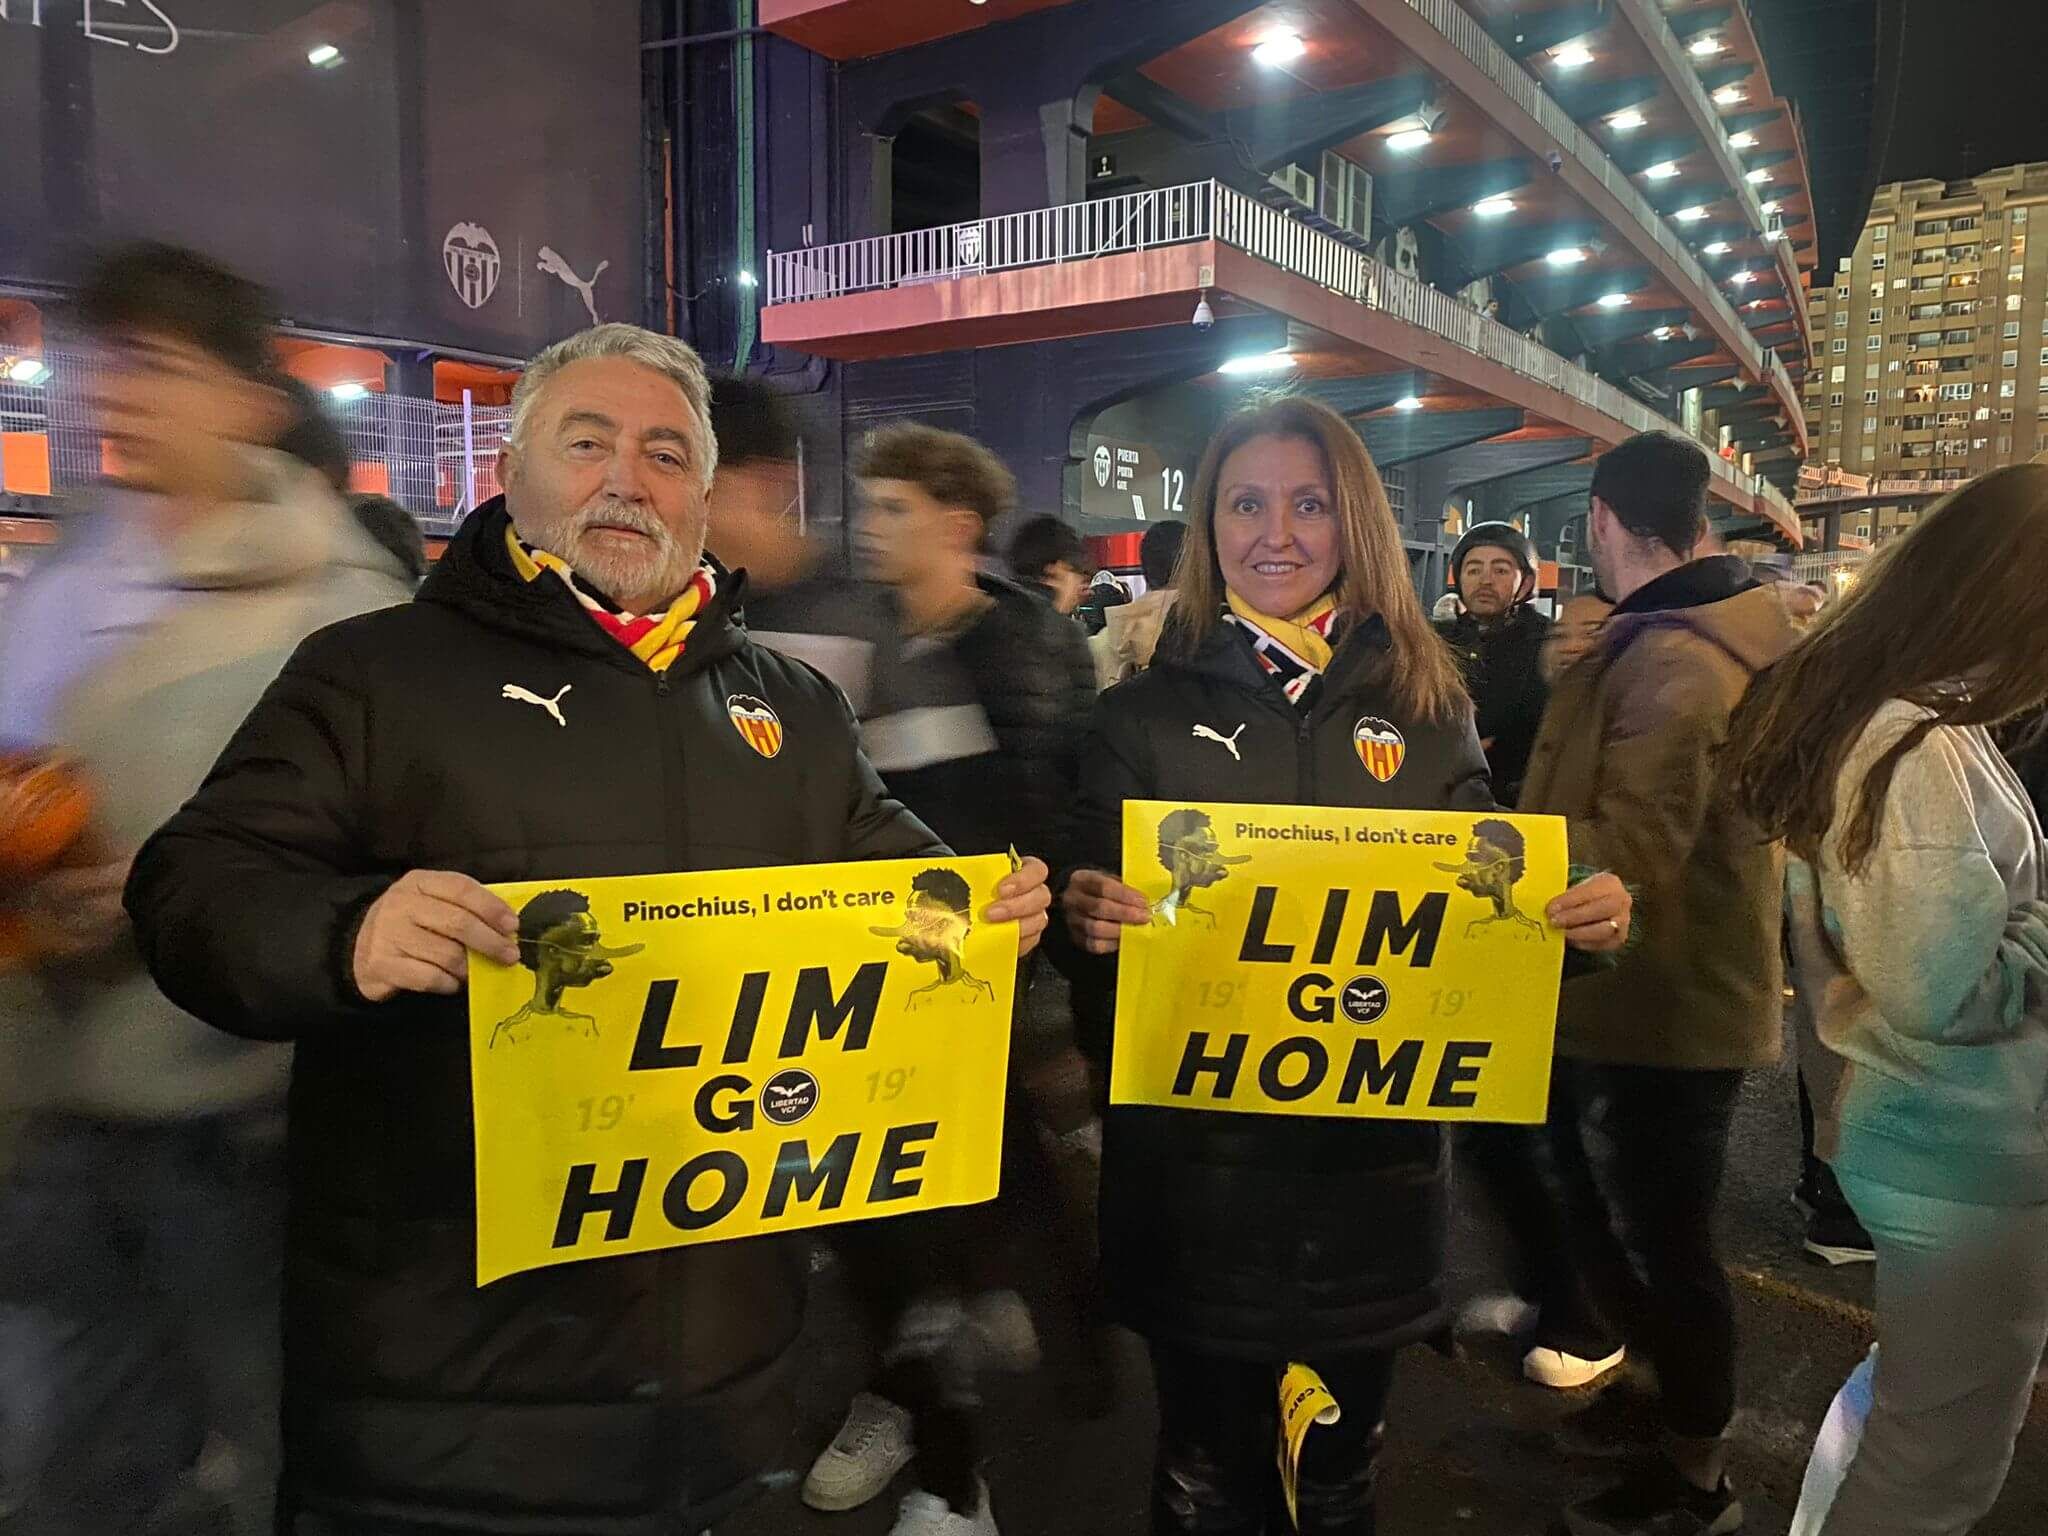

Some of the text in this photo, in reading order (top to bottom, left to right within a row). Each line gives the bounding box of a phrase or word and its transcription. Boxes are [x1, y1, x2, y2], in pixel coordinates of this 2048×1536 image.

[1162, 467, 1184, 511] 12
[1466, 499, 1473, 528] 8
[1235, 822, 1457, 847] Pinochius, I don't care
[622, 896, 757, 922] Pinochius,
[763, 894, 770, 913] I
[843, 887, 895, 907] care
[1238, 886, 1450, 968] LIM
[627, 961, 888, 1071] LIM
[1171, 1031, 1492, 1108] HOME
[770, 1096, 809, 1109] LIBERTAD
[780, 1105, 797, 1114] VCF
[551, 1121, 939, 1249] HOME
